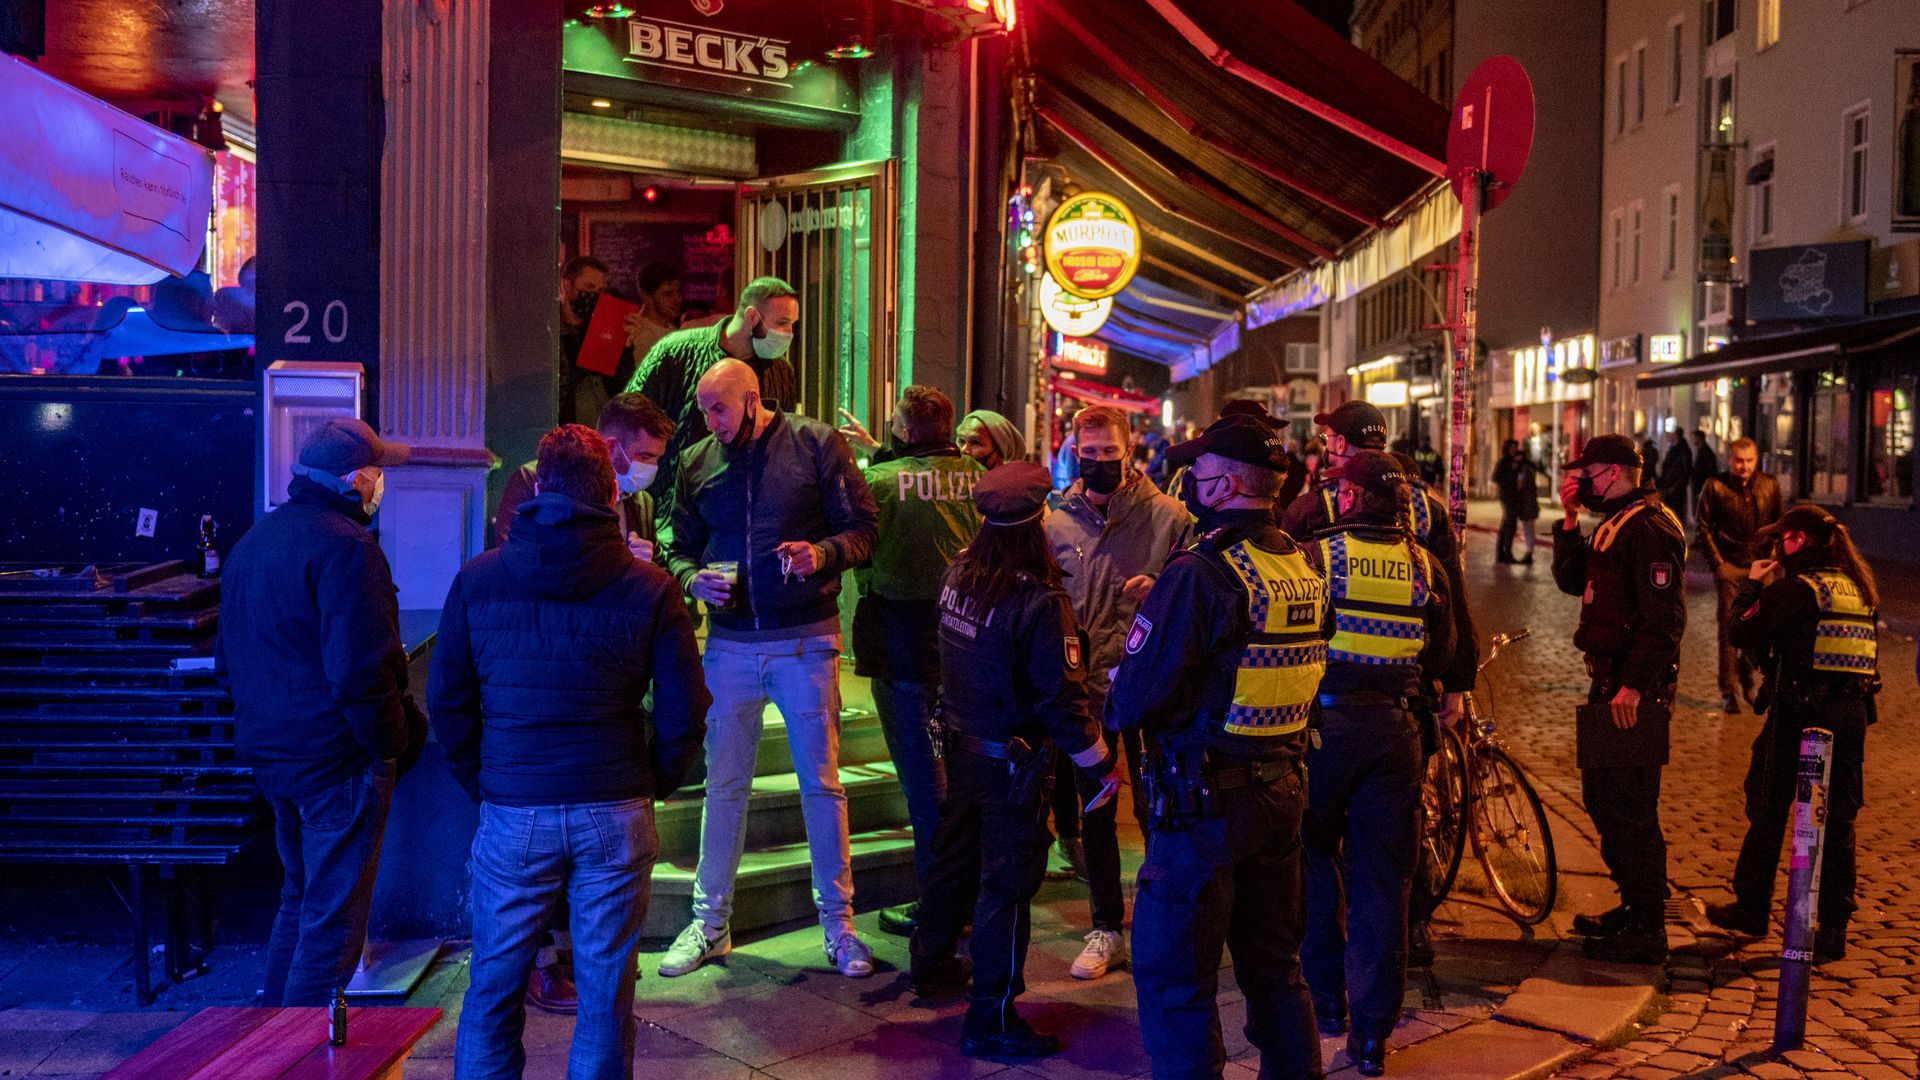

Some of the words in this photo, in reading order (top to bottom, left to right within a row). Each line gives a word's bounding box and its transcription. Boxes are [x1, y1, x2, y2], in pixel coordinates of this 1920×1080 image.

[628, 20, 789, 79] BECK'S
[283, 300, 349, 344] 20
[1349, 557, 1412, 582] POLIZEI
[1267, 578, 1323, 602] POLIZEI
[1827, 580, 1857, 597] POLIZ
